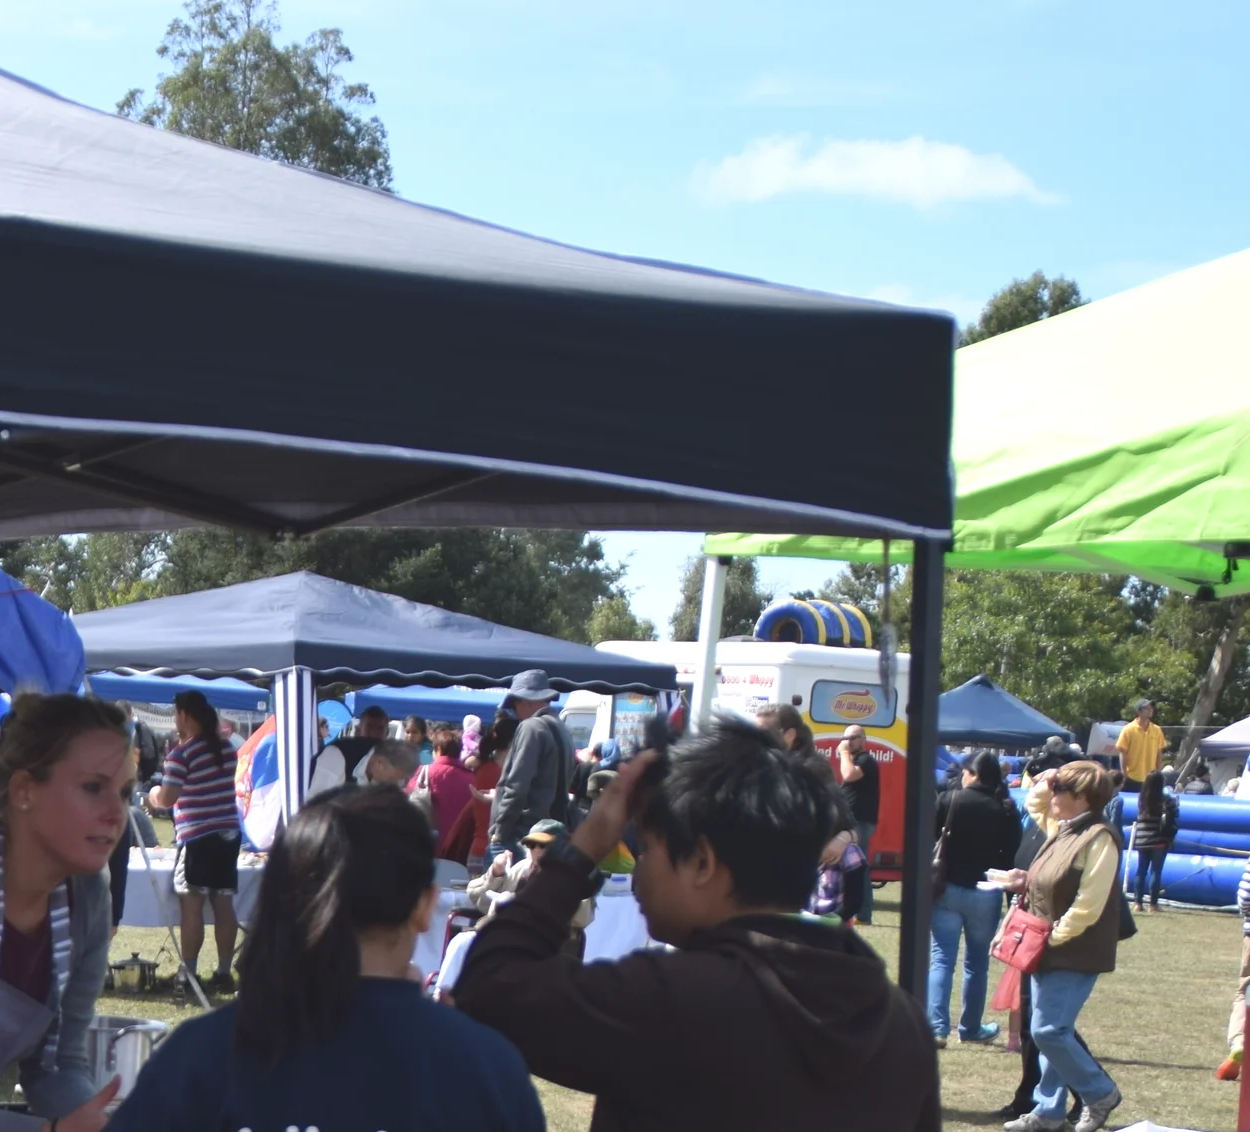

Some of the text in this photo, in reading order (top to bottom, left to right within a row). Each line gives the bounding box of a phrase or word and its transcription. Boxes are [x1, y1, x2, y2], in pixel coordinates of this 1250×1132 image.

[749, 674, 774, 687] Whippy
[834, 700, 873, 714] Mr Whippy
[870, 748, 894, 761] hild!
